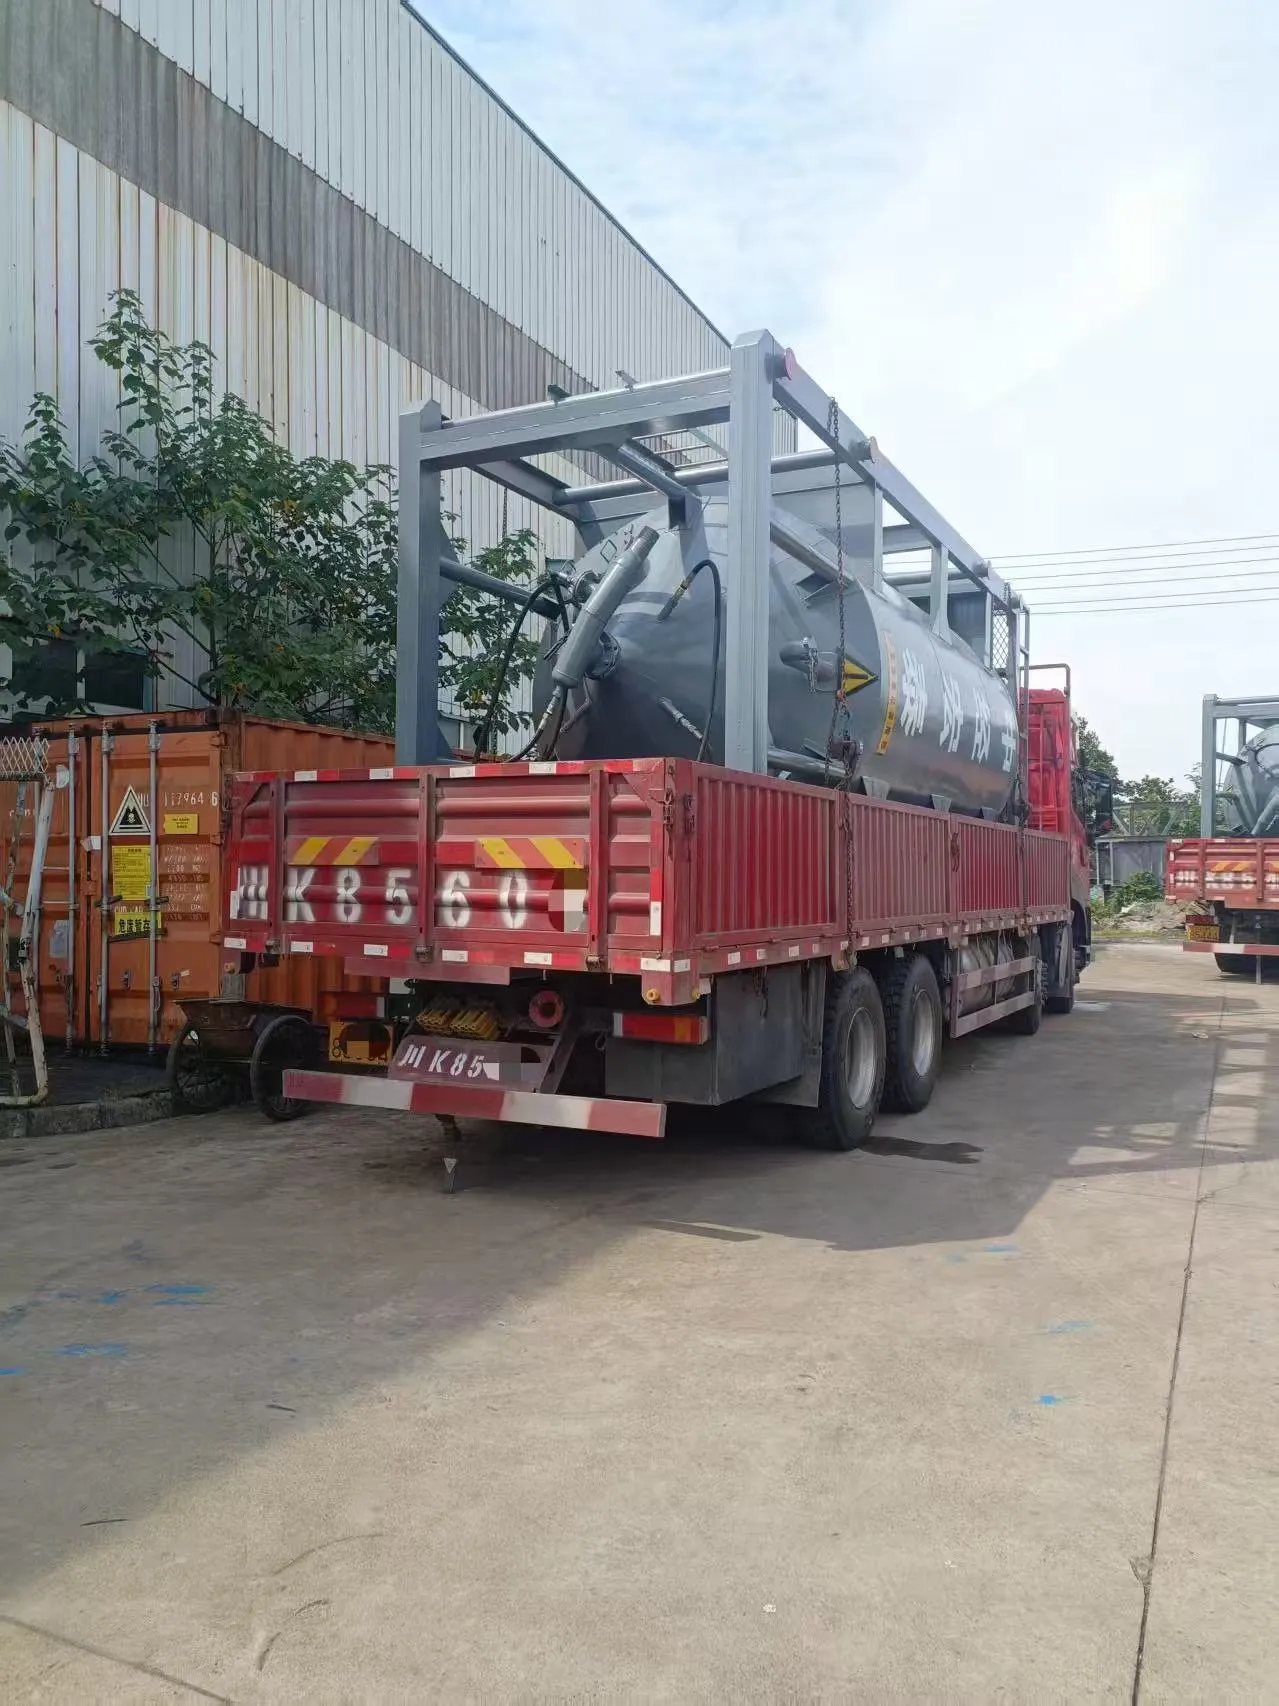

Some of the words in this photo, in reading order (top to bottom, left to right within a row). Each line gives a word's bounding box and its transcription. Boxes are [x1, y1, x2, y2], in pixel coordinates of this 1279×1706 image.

[239, 864, 572, 930] 川K8560
[118, 917, 153, 934] 危废暂存
[398, 1044, 497, 1081] 川K85
